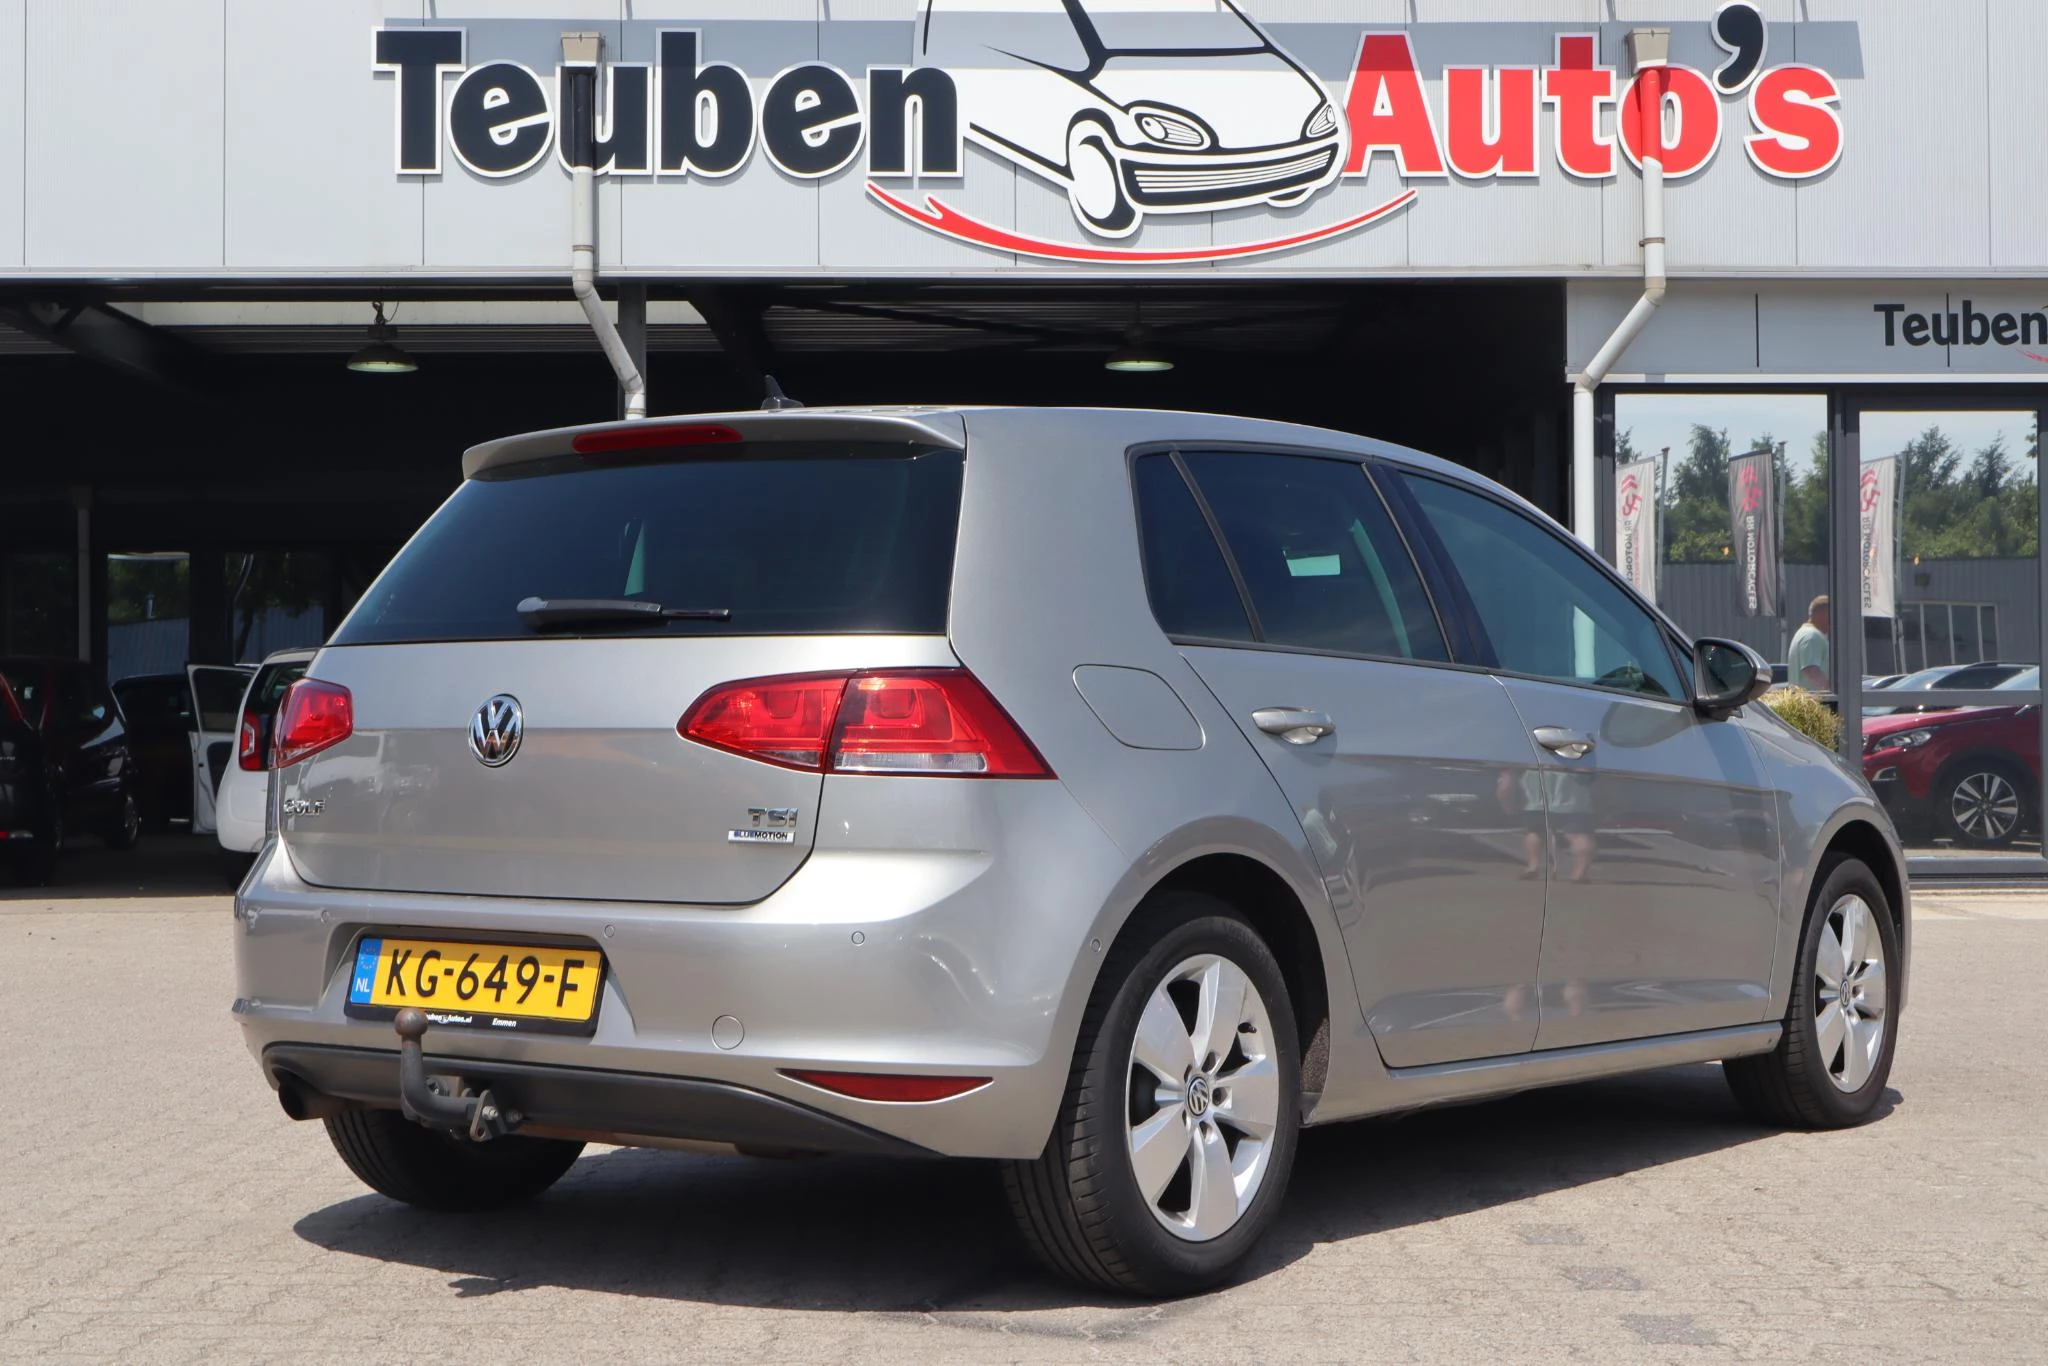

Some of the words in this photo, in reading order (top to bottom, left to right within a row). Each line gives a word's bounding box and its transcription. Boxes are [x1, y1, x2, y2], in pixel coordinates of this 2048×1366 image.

[374, 29, 959, 175] Teuben
[1343, 3, 1841, 176] Auto's
[1873, 299, 2048, 347] Teuben
[283, 799, 326, 816] GOLF
[747, 806, 799, 828] TSI
[733, 830, 788, 840] BLUEMOTION
[355, 977, 371, 993] NL
[385, 948, 585, 1007] KG-649-F
[491, 1017, 517, 1028] Emmen
